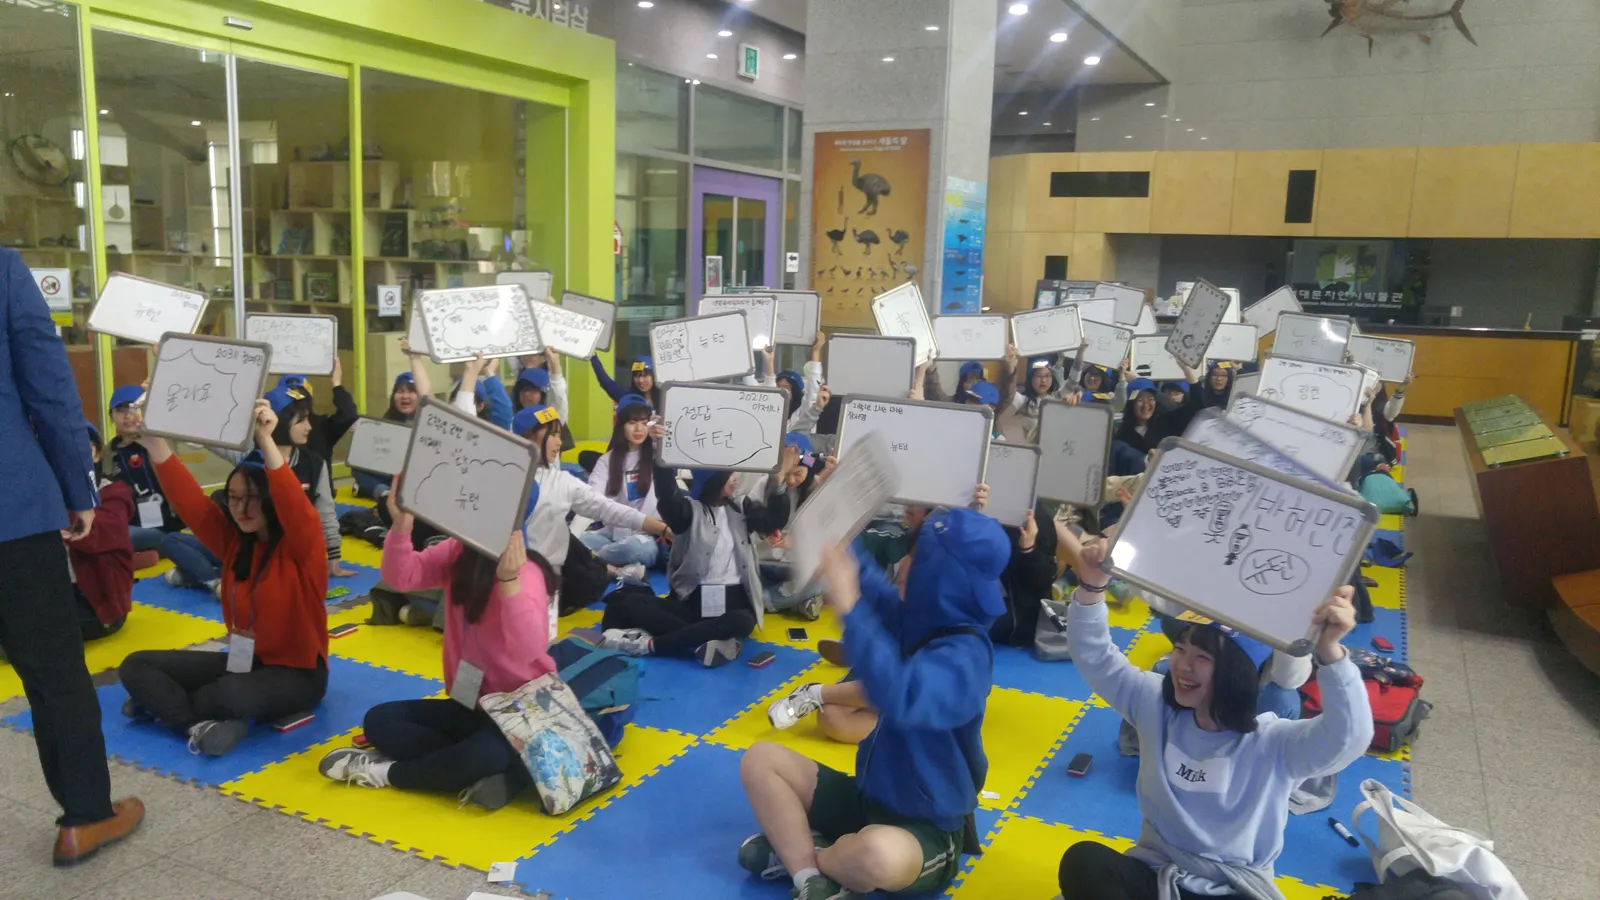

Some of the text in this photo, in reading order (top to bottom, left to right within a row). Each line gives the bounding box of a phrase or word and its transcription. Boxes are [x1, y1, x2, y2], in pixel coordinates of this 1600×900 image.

[739, 391, 768, 402] 20210
[681, 404, 712, 421] 정답
[692, 427, 735, 449] 뉴턴
[1245, 554, 1295, 586] 뉴턴
[1175, 762, 1206, 782] Milk
